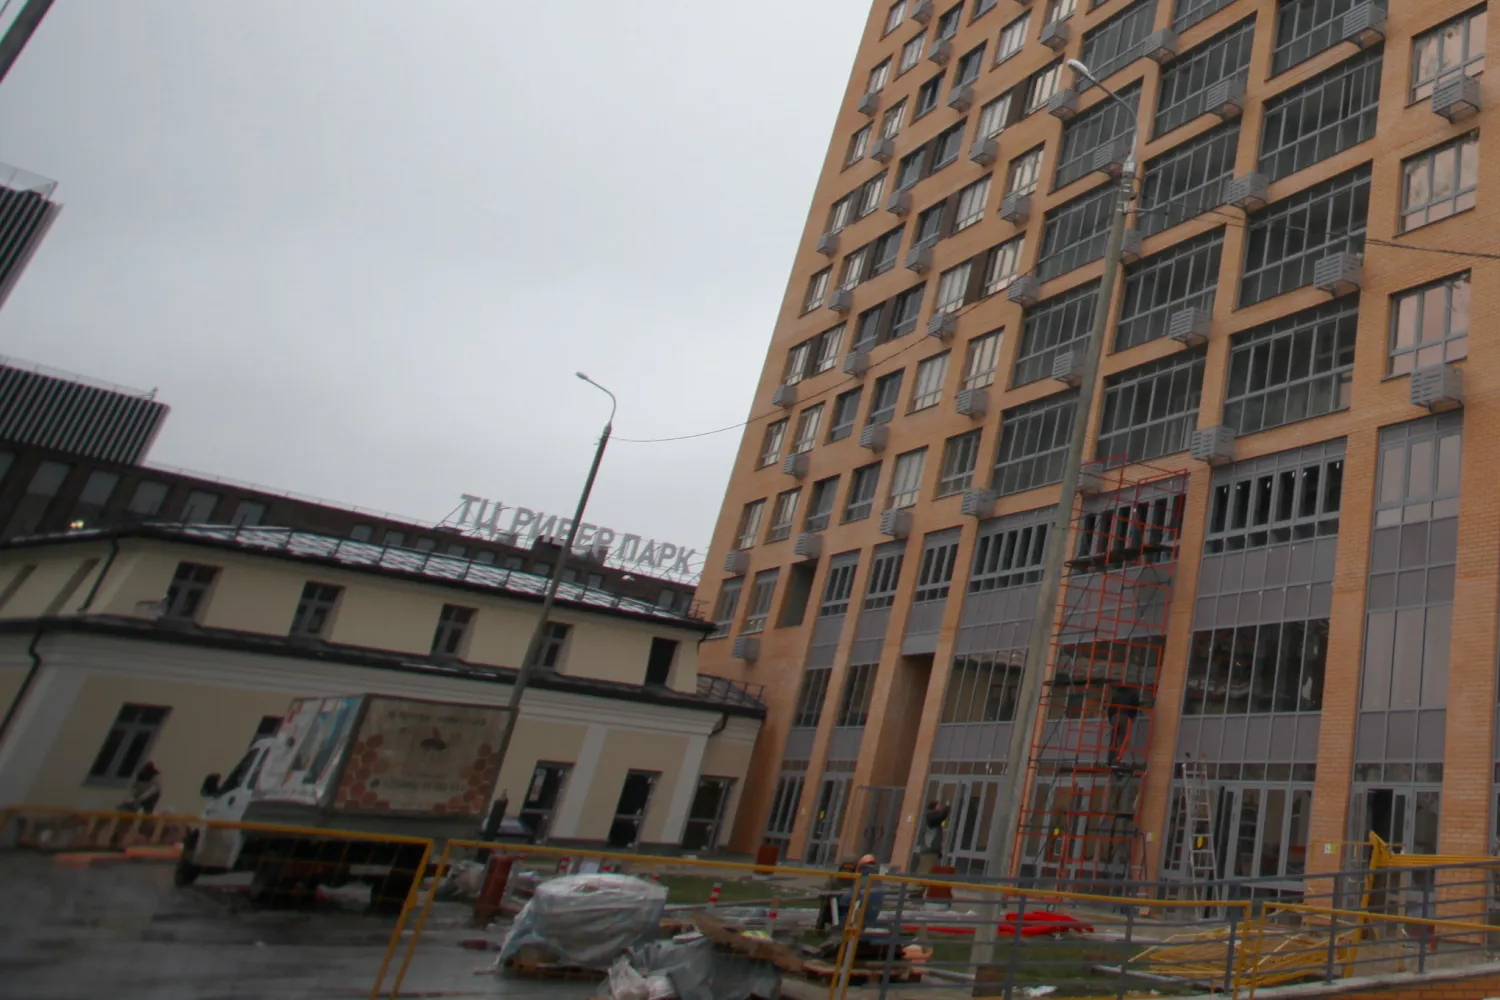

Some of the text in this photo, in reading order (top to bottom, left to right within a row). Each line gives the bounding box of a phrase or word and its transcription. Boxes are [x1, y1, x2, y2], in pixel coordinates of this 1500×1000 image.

[457, 493, 697, 574] ТЦ РИВЕР ПАРК
